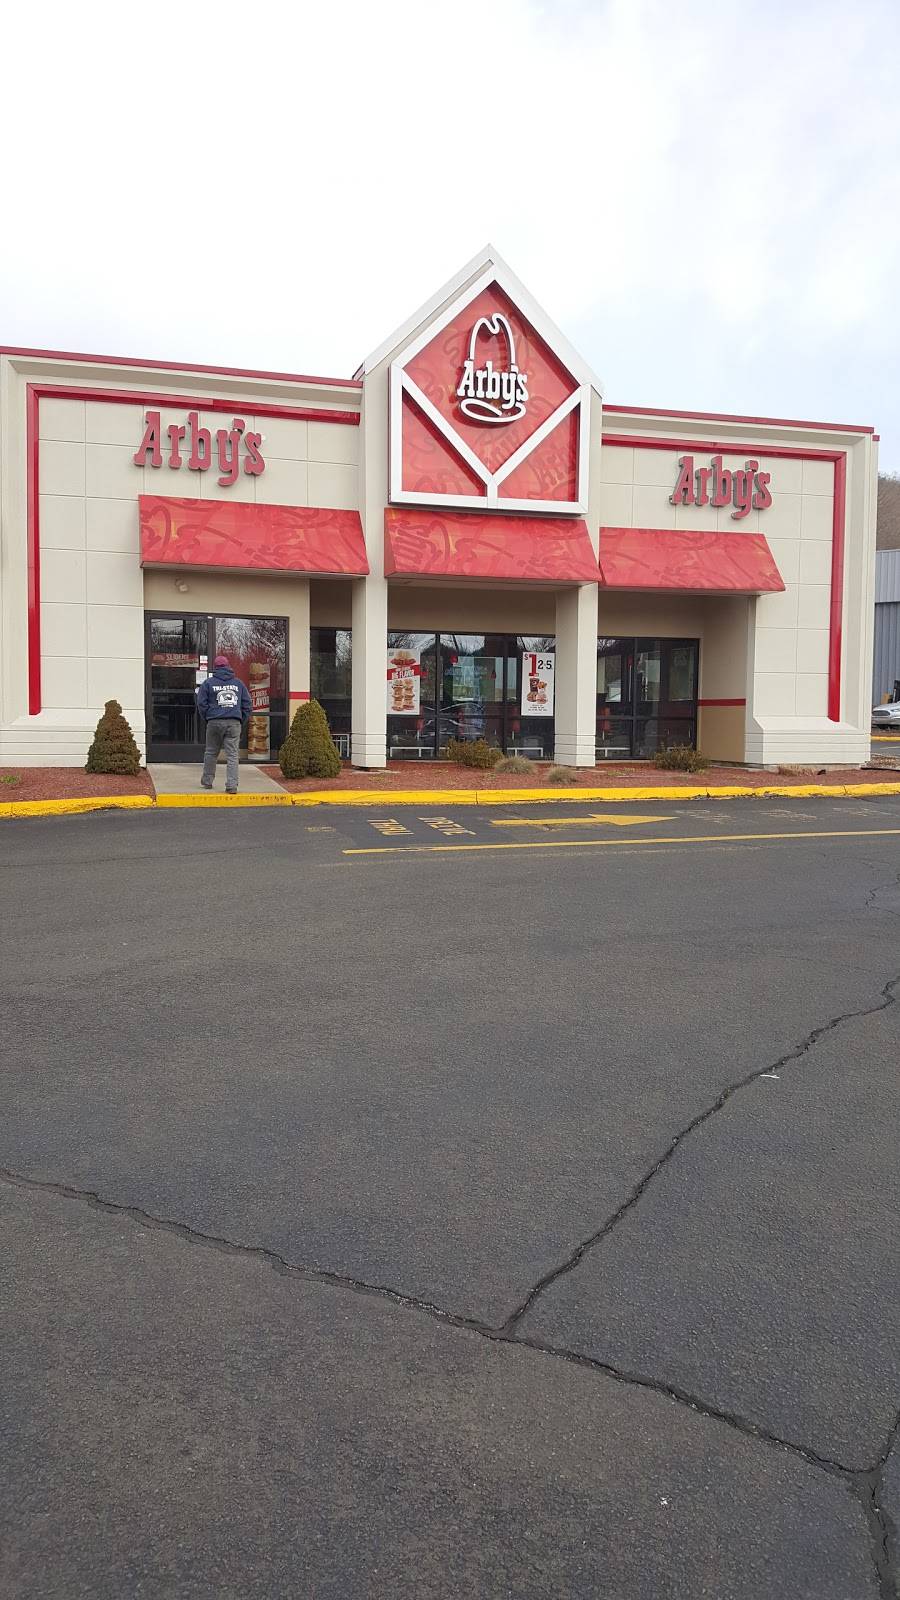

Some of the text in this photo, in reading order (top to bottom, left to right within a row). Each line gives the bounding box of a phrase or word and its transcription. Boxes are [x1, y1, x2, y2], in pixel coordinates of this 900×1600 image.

[457, 360, 529, 410] Arby's
[133, 411, 265, 486] Arby's
[669, 456, 772, 519] Arby's
